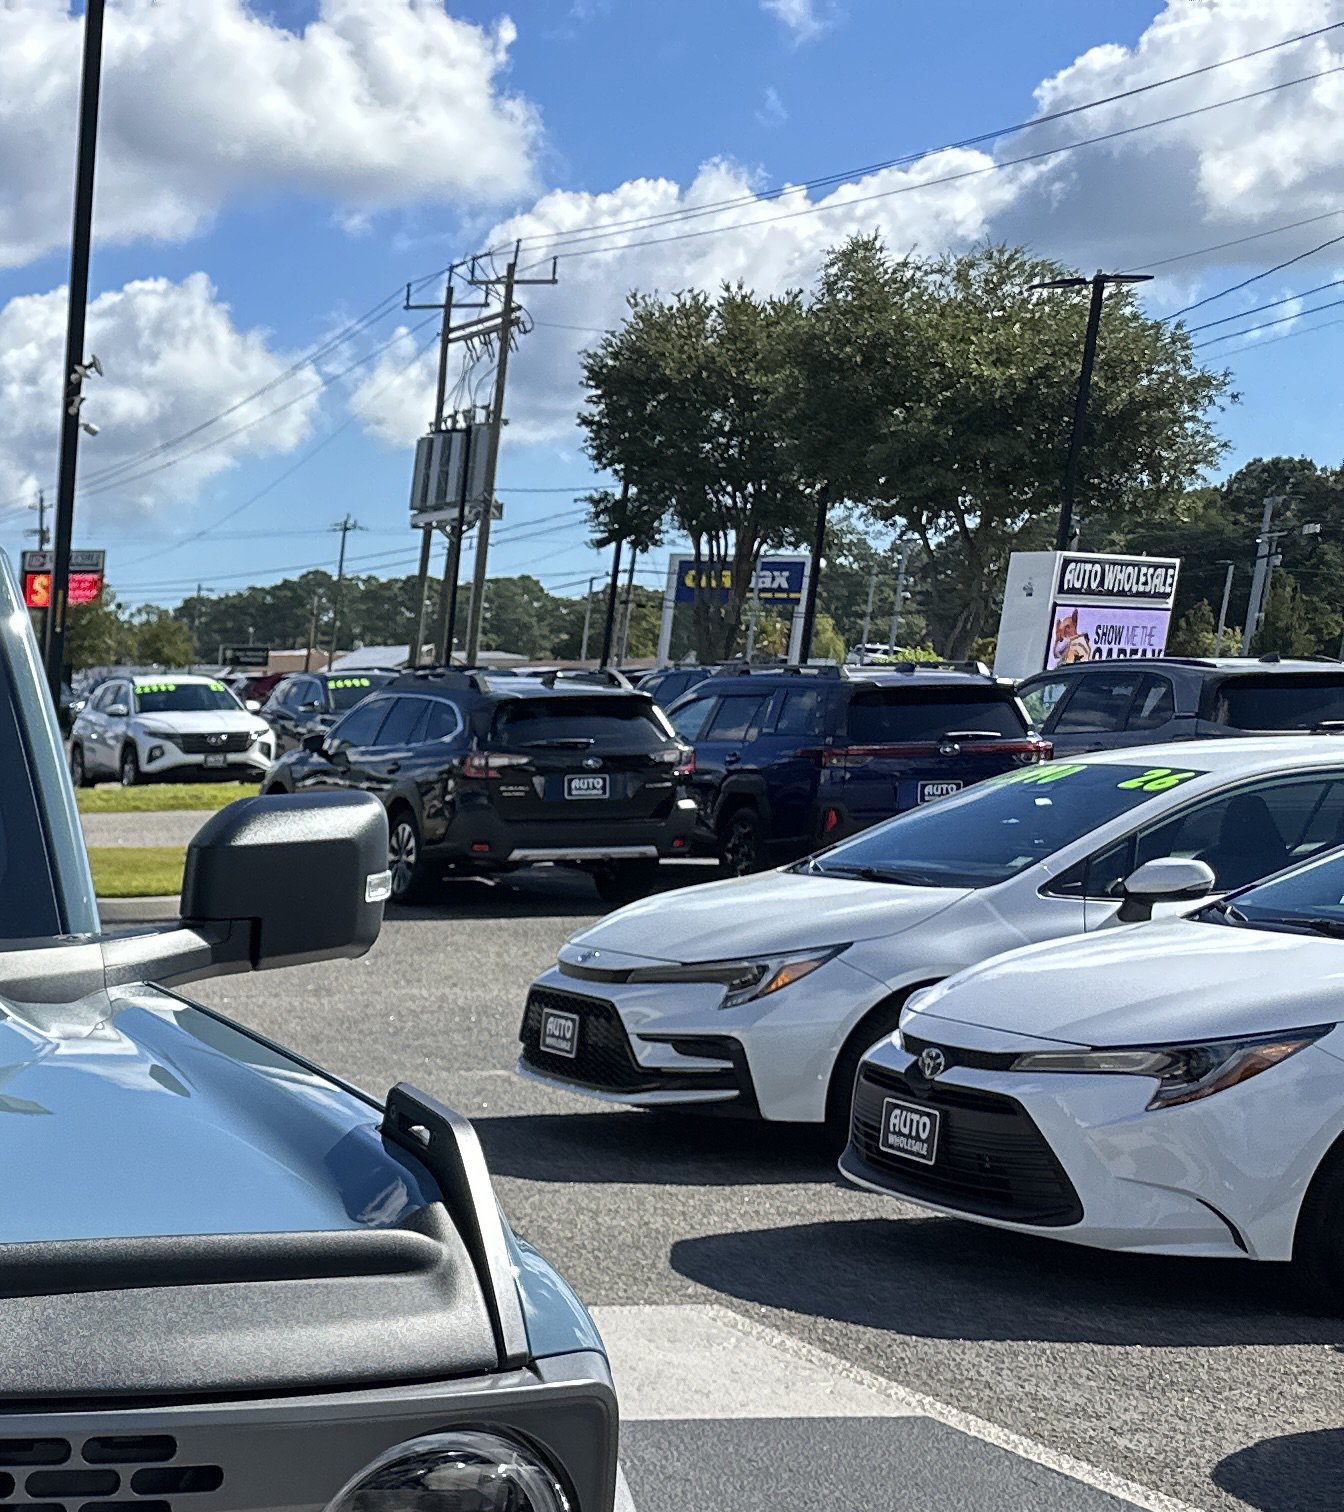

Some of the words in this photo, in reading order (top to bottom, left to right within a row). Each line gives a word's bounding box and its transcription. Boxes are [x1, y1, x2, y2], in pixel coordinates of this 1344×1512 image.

[1063, 562, 1102, 592] AUTO
[1103, 563, 1175, 594] WHOLESALE
[1093, 624, 1124, 646] SHOW
[571, 777, 604, 790] AUTO
[924, 783, 958, 796] AUTO
[1117, 768, 1196, 792] 26
[545, 1016, 574, 1039] AUTO
[889, 1108, 931, 1140] AUTO
